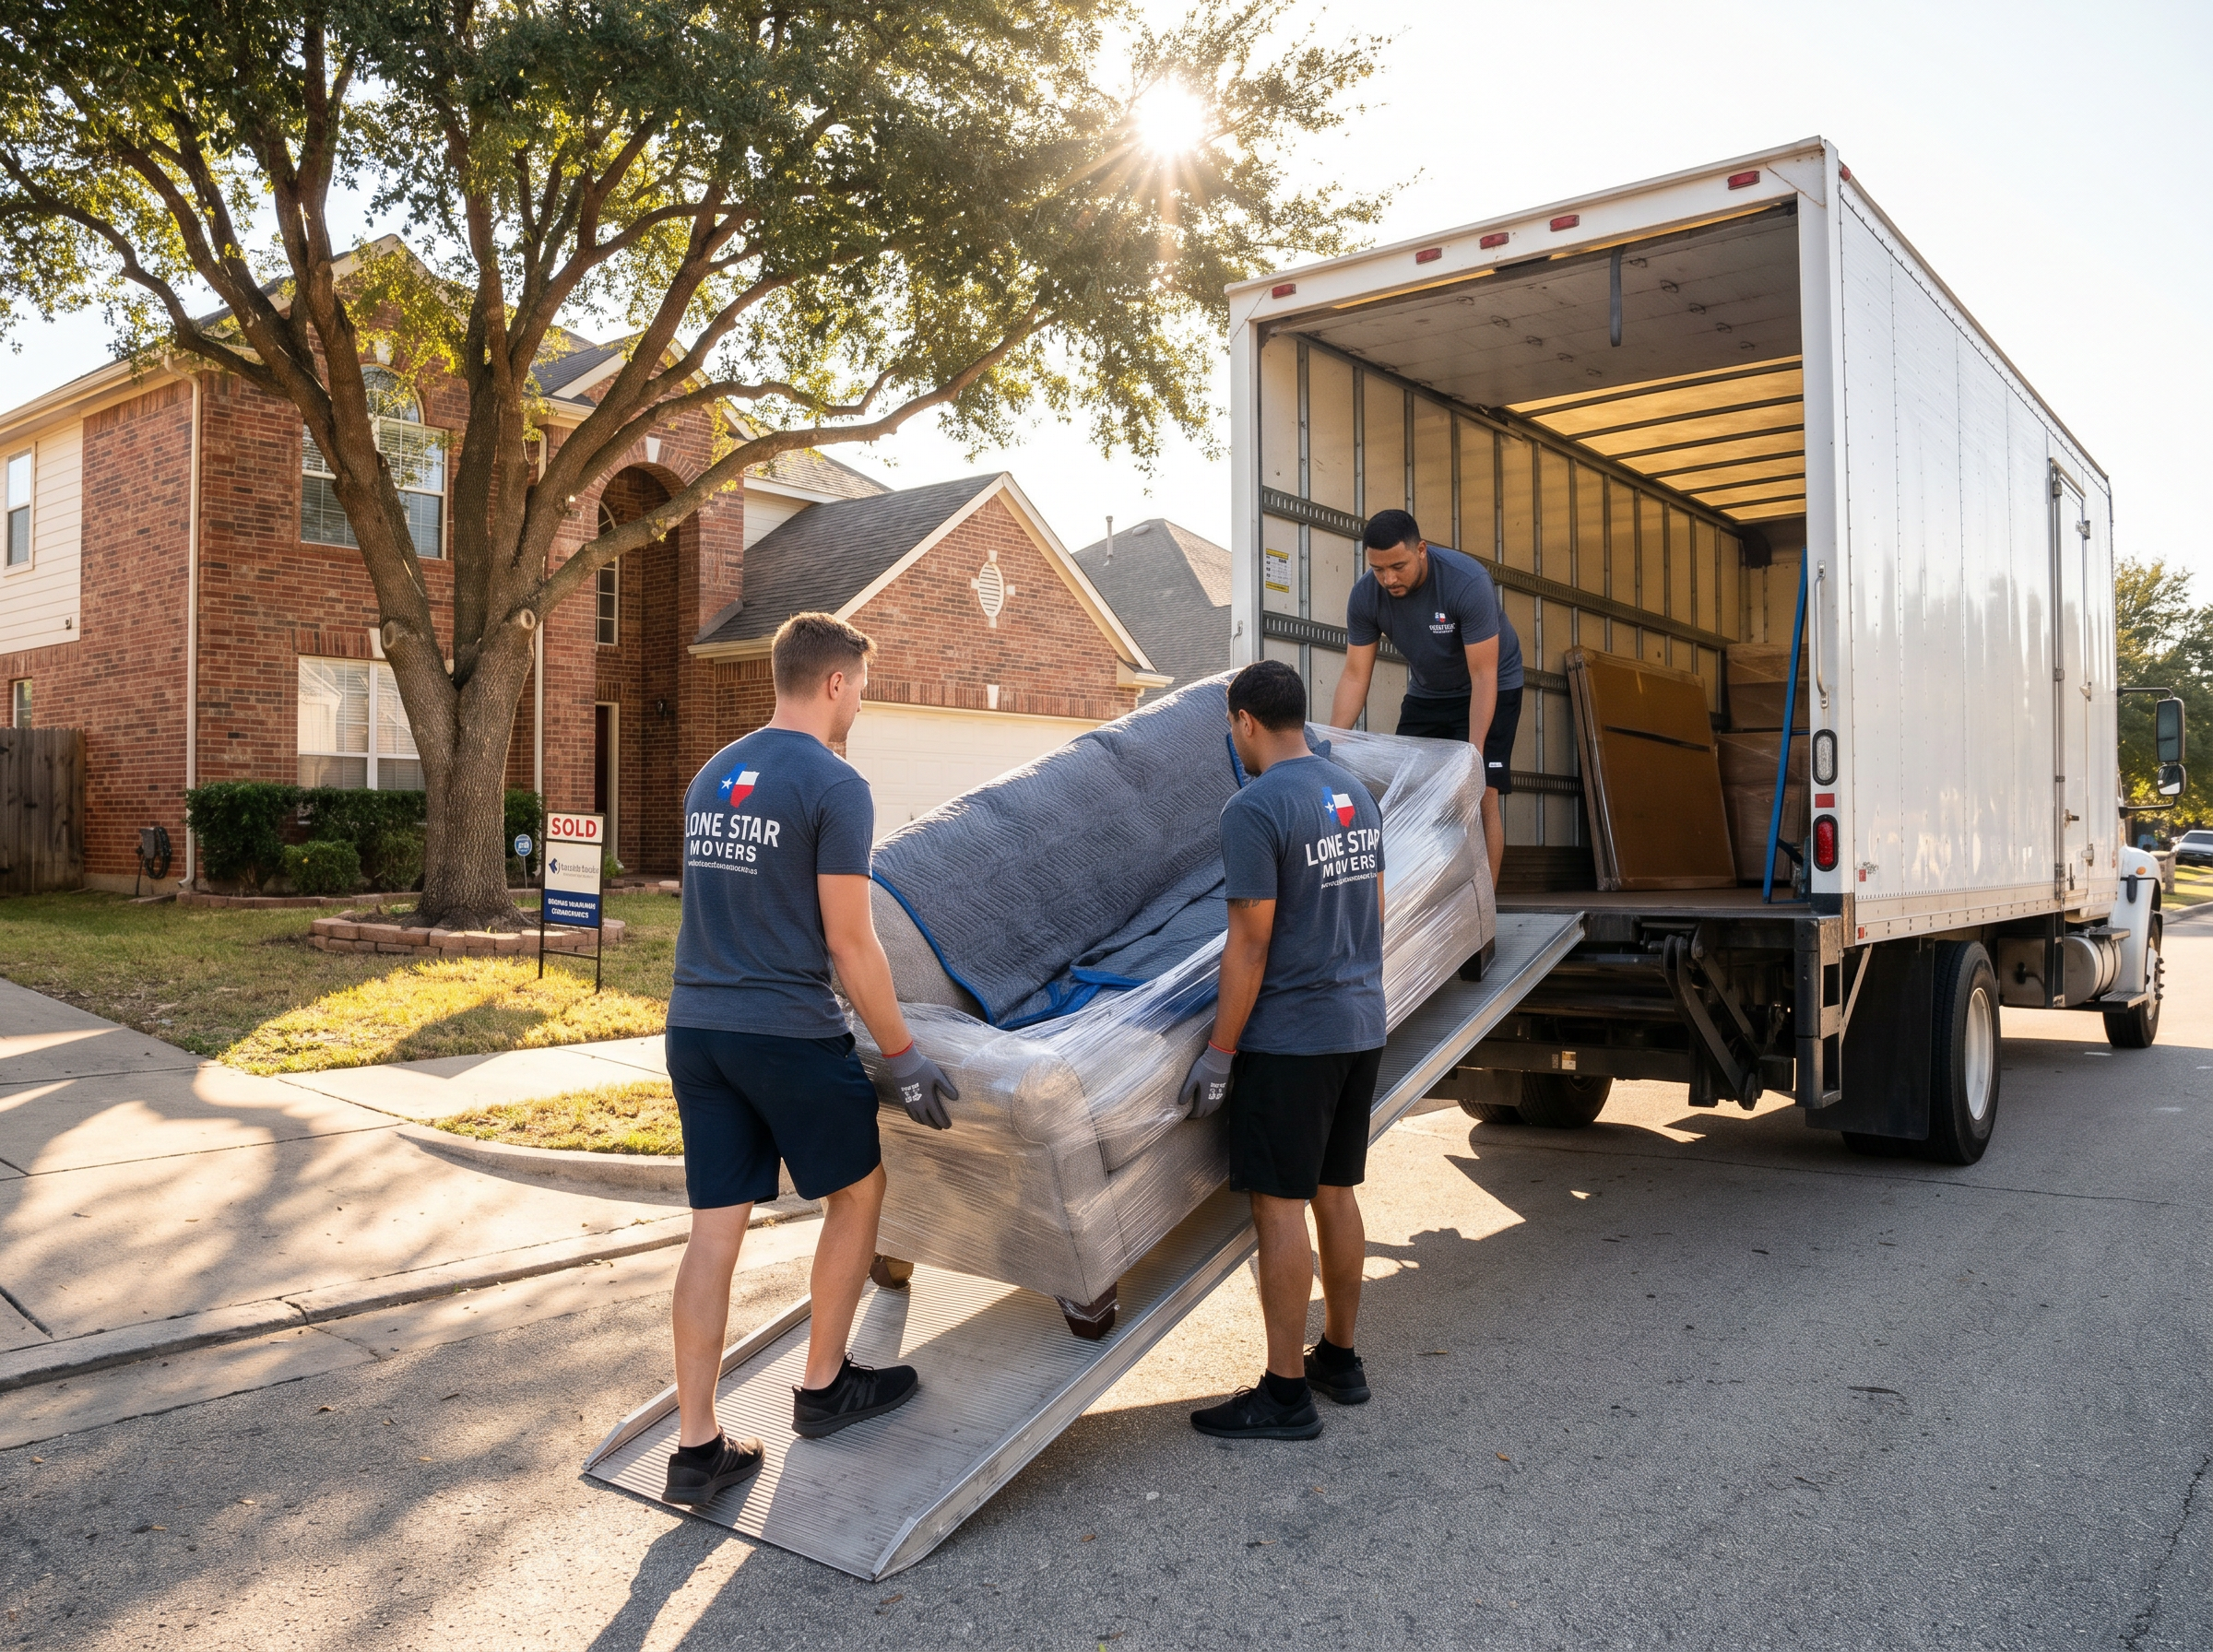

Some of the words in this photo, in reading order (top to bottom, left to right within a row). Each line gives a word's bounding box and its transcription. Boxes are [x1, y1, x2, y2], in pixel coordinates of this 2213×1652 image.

[551, 817, 598, 838] SOLD
[685, 812, 724, 838] LONE
[728, 814, 781, 848] STAR
[690, 840, 757, 863] MOVERS
[1306, 833, 1344, 866] LONE
[1322, 854, 1376, 879] MOVERS
